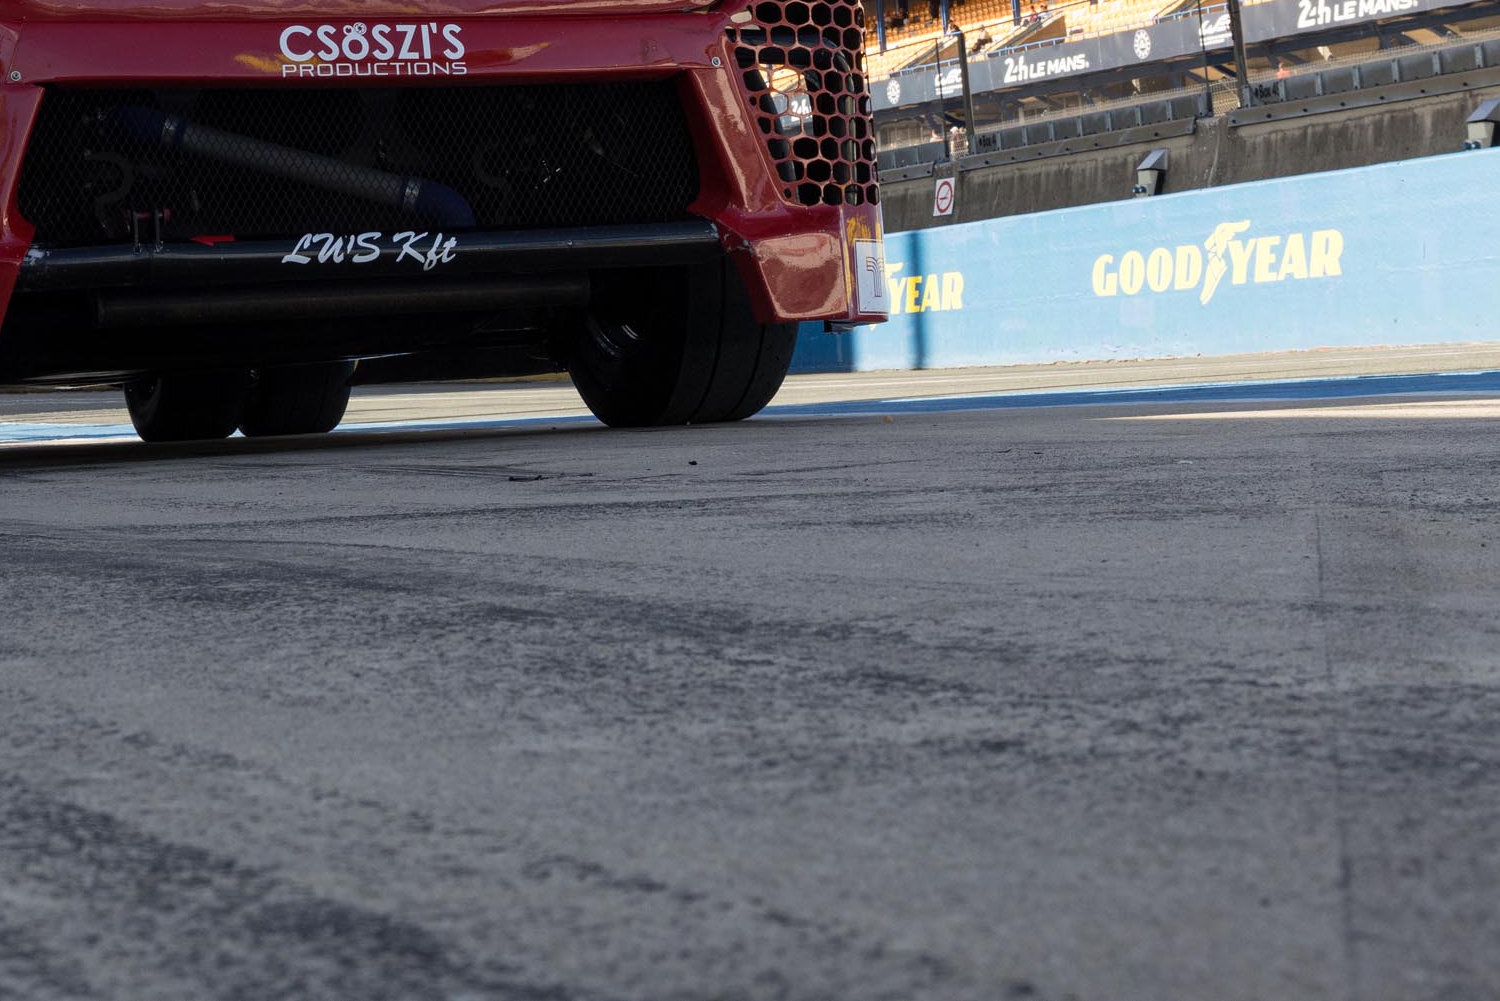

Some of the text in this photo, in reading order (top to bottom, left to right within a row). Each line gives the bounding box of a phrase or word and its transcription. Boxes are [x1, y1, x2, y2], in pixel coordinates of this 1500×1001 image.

[1333, 0, 1356, 22] LE
[282, 62, 468, 77] PRODUCTIONS
[1003, 54, 1088, 83] 24h LE MANS
[393, 231, 458, 271] Kft
